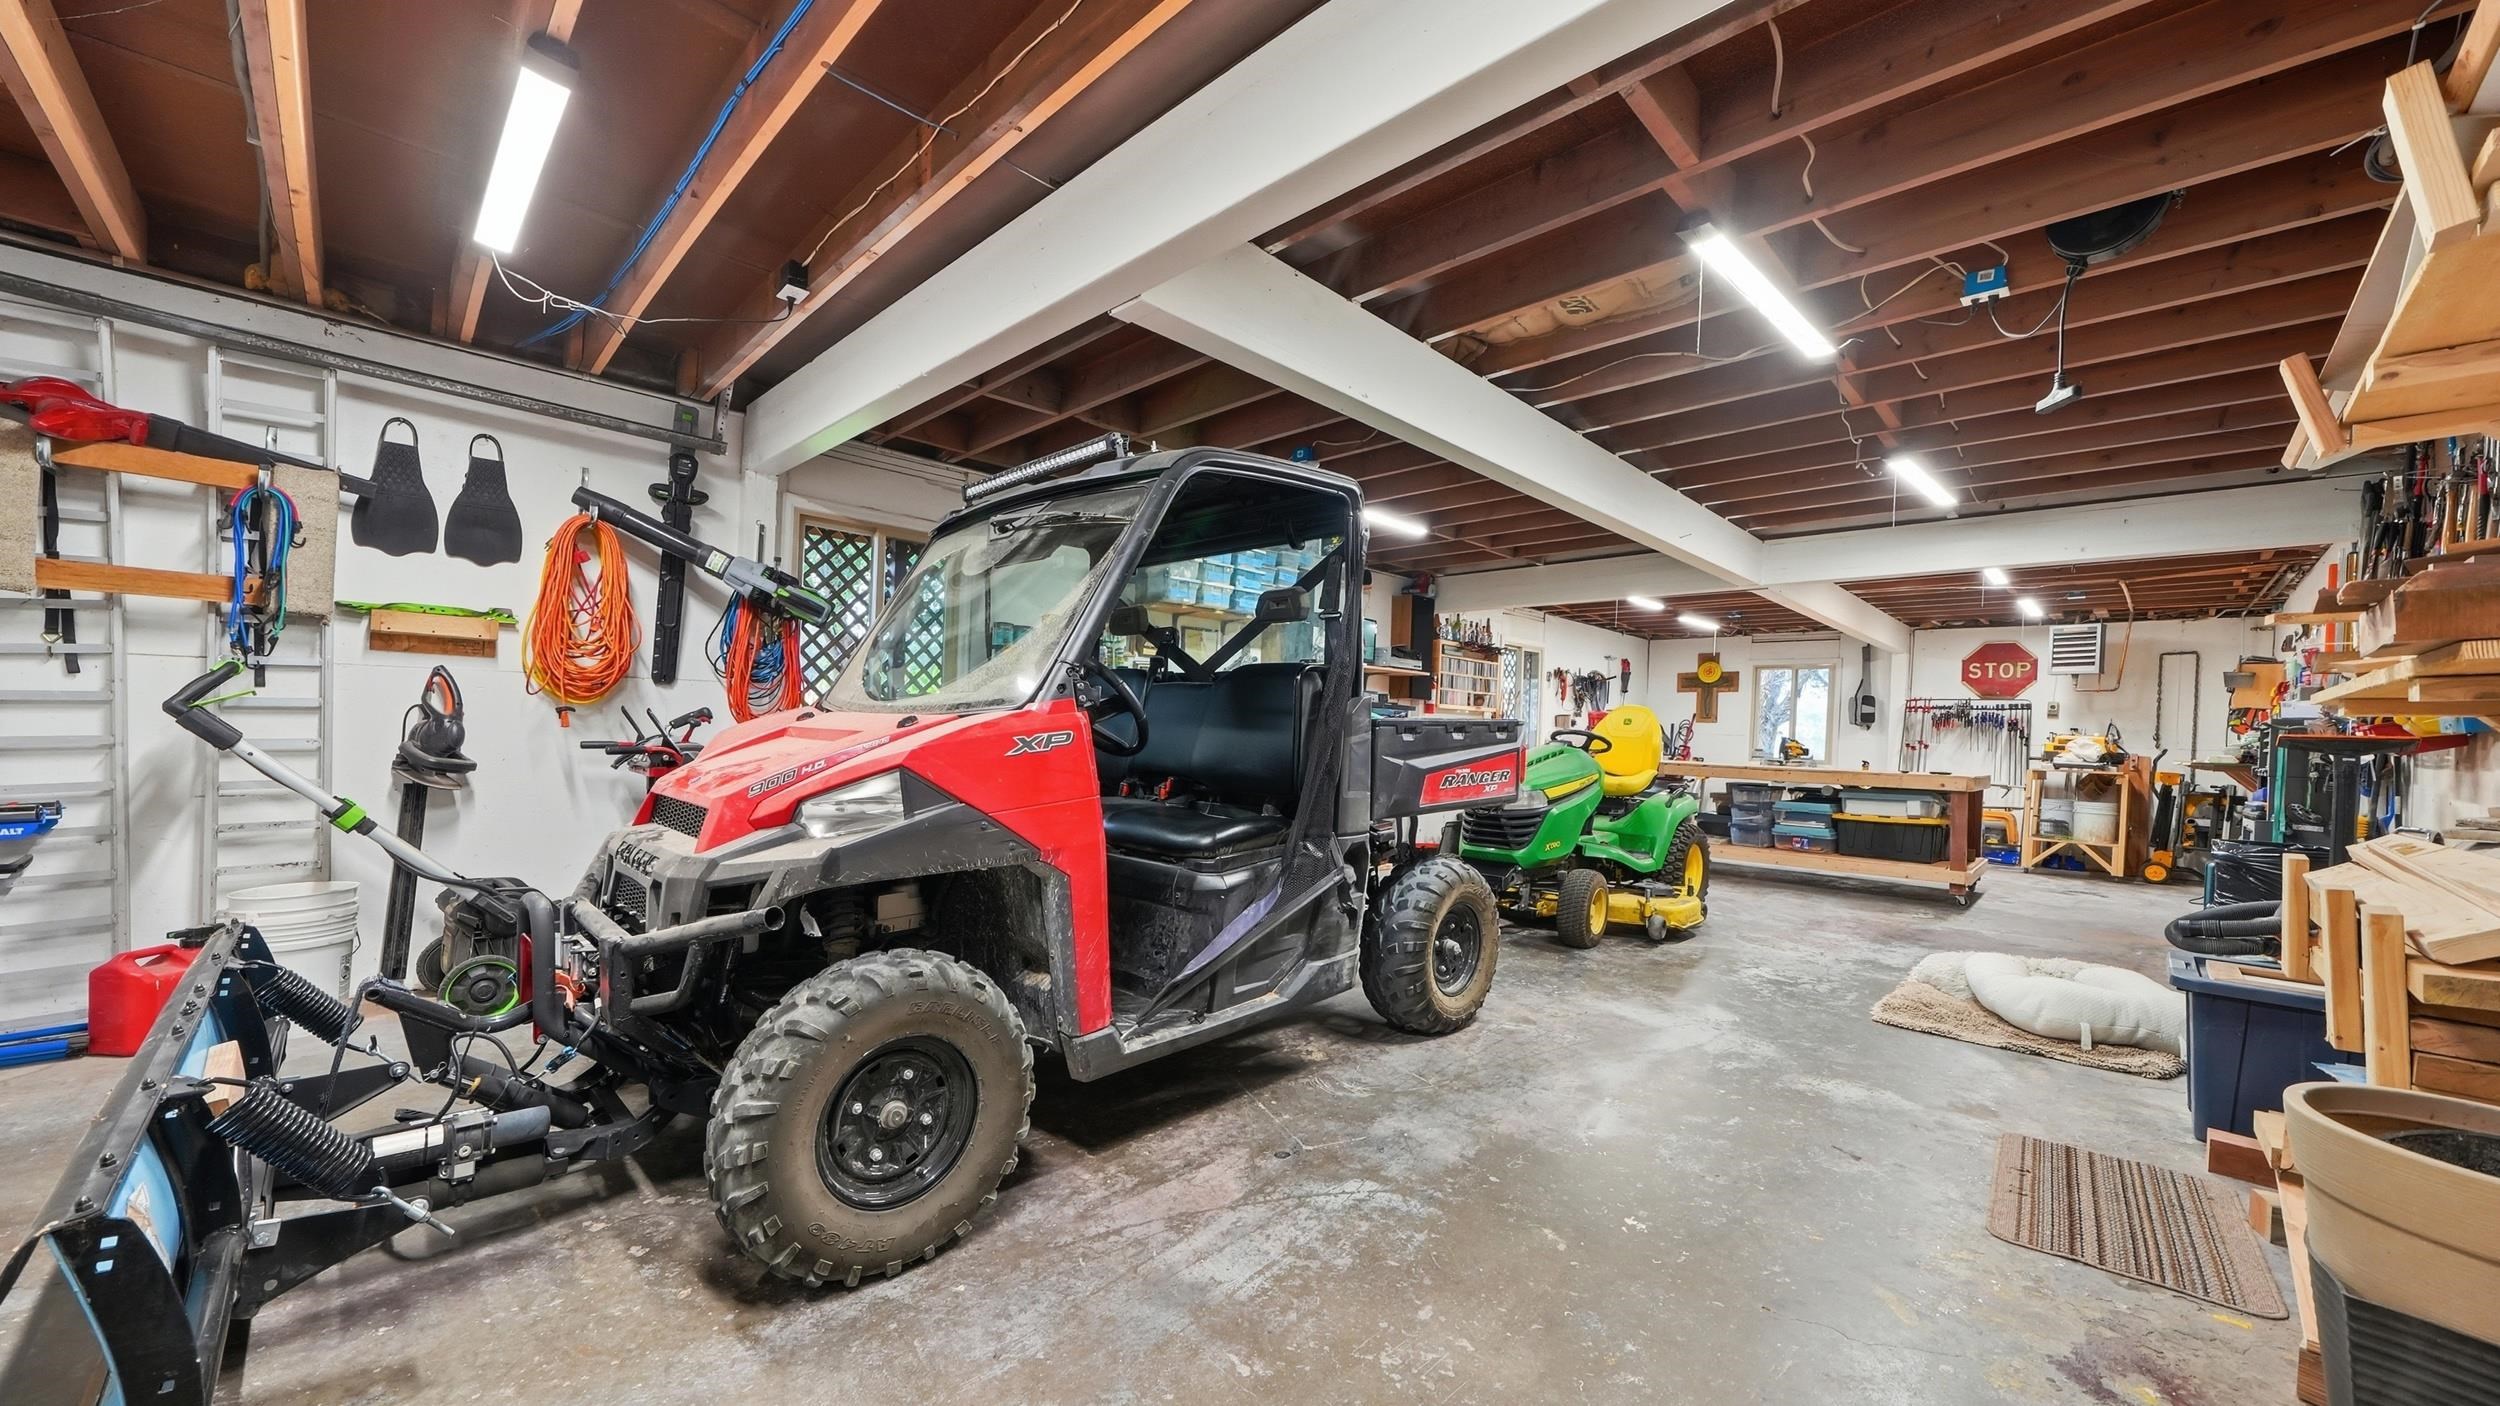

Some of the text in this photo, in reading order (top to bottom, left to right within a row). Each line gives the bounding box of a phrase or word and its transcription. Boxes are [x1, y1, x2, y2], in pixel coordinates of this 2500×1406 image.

[1967, 661, 2032, 679] STOP
[1003, 730, 1074, 756] XP
[746, 767, 799, 799] 900
[1439, 769, 1511, 789] RANGER
[1482, 784, 1499, 793] XP
